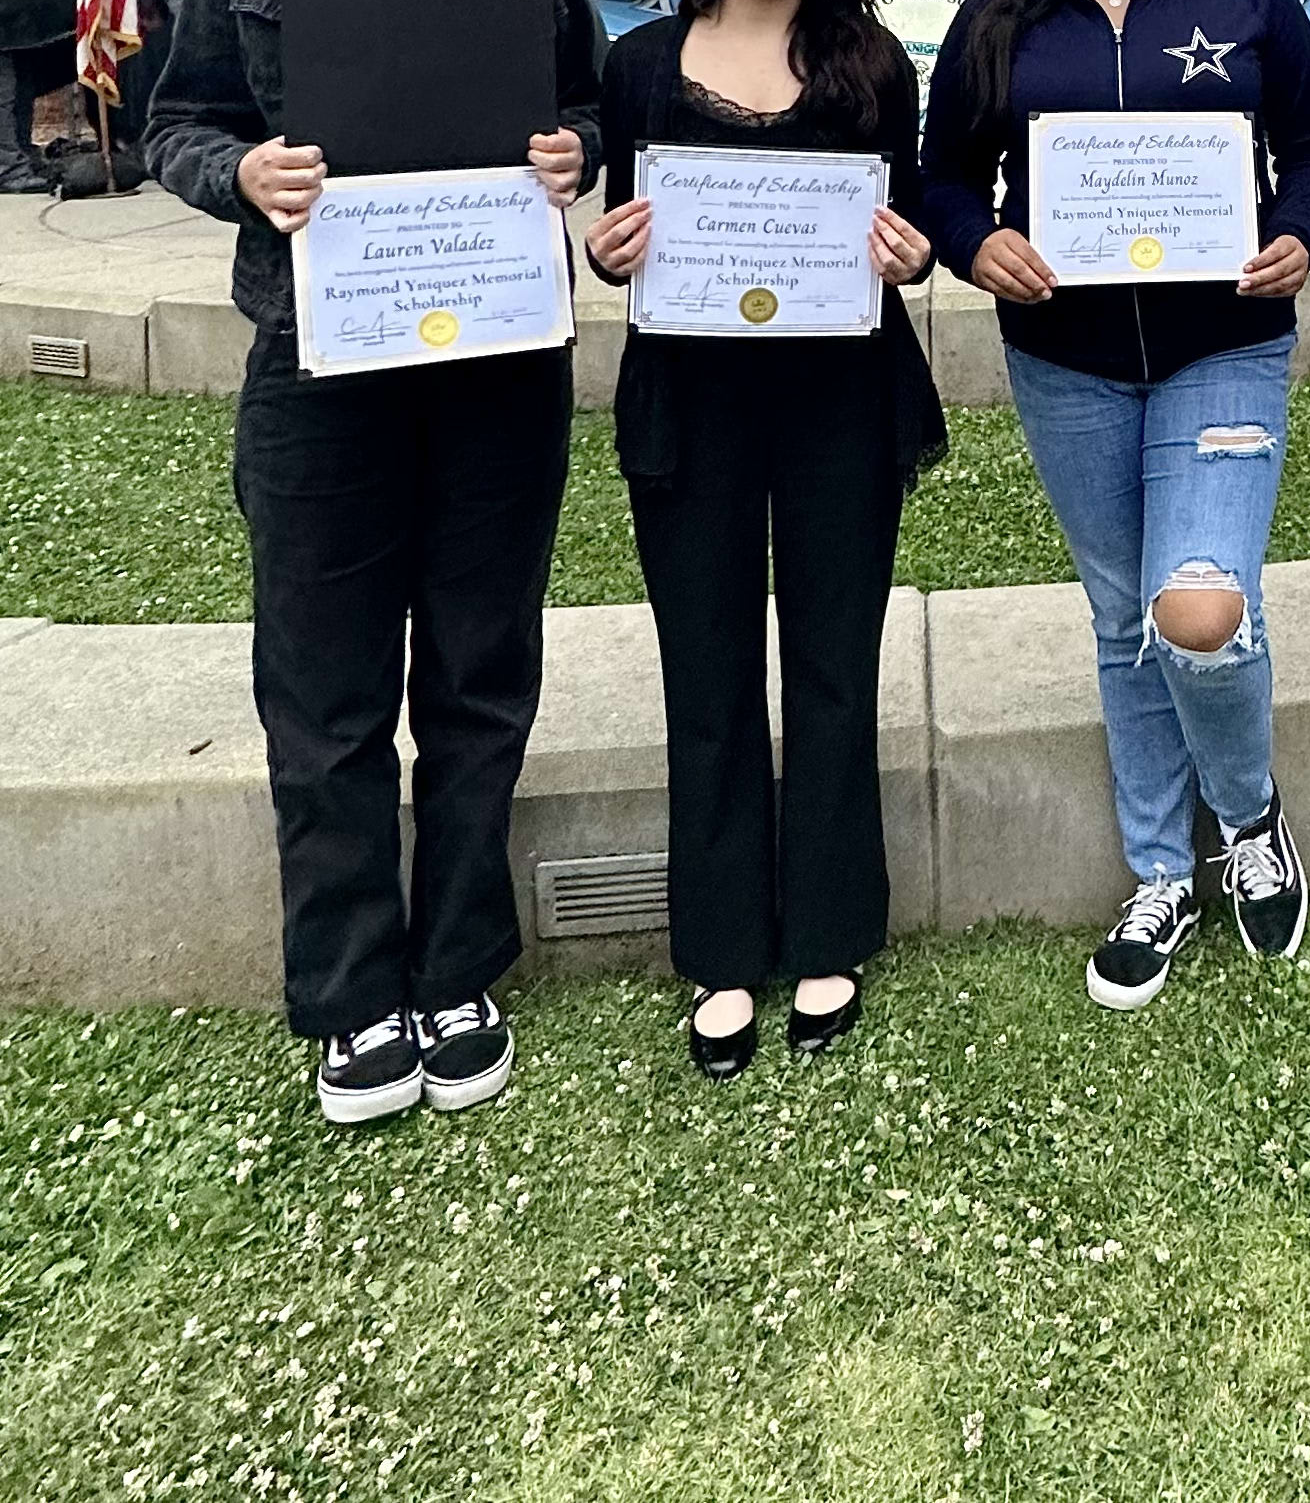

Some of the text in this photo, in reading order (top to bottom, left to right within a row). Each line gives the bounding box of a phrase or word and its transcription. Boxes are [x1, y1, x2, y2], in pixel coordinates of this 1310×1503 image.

[1052, 134, 1229, 156] Certificate of Scholarship
[660, 172, 862, 201] Certificate of Scholarship
[1080, 169, 1198, 194] Maydelin Munoz
[320, 191, 533, 225] Certificate of Scholarship
[1052, 204, 1233, 223] Raymond Yniquez Memorial
[696, 215, 817, 234] Carmen Cuevas
[1106, 222, 1181, 237] Scholarship
[362, 232, 496, 260] Lauren Valadez
[657, 251, 858, 271] Raymond Yniquez Memorial
[325, 279, 400, 303] Raymond
[404, 277, 467, 296] Yniquez
[472, 266, 542, 286] Memorial
[715, 273, 799, 290] Scholarship
[393, 293, 483, 312] Scholarship
